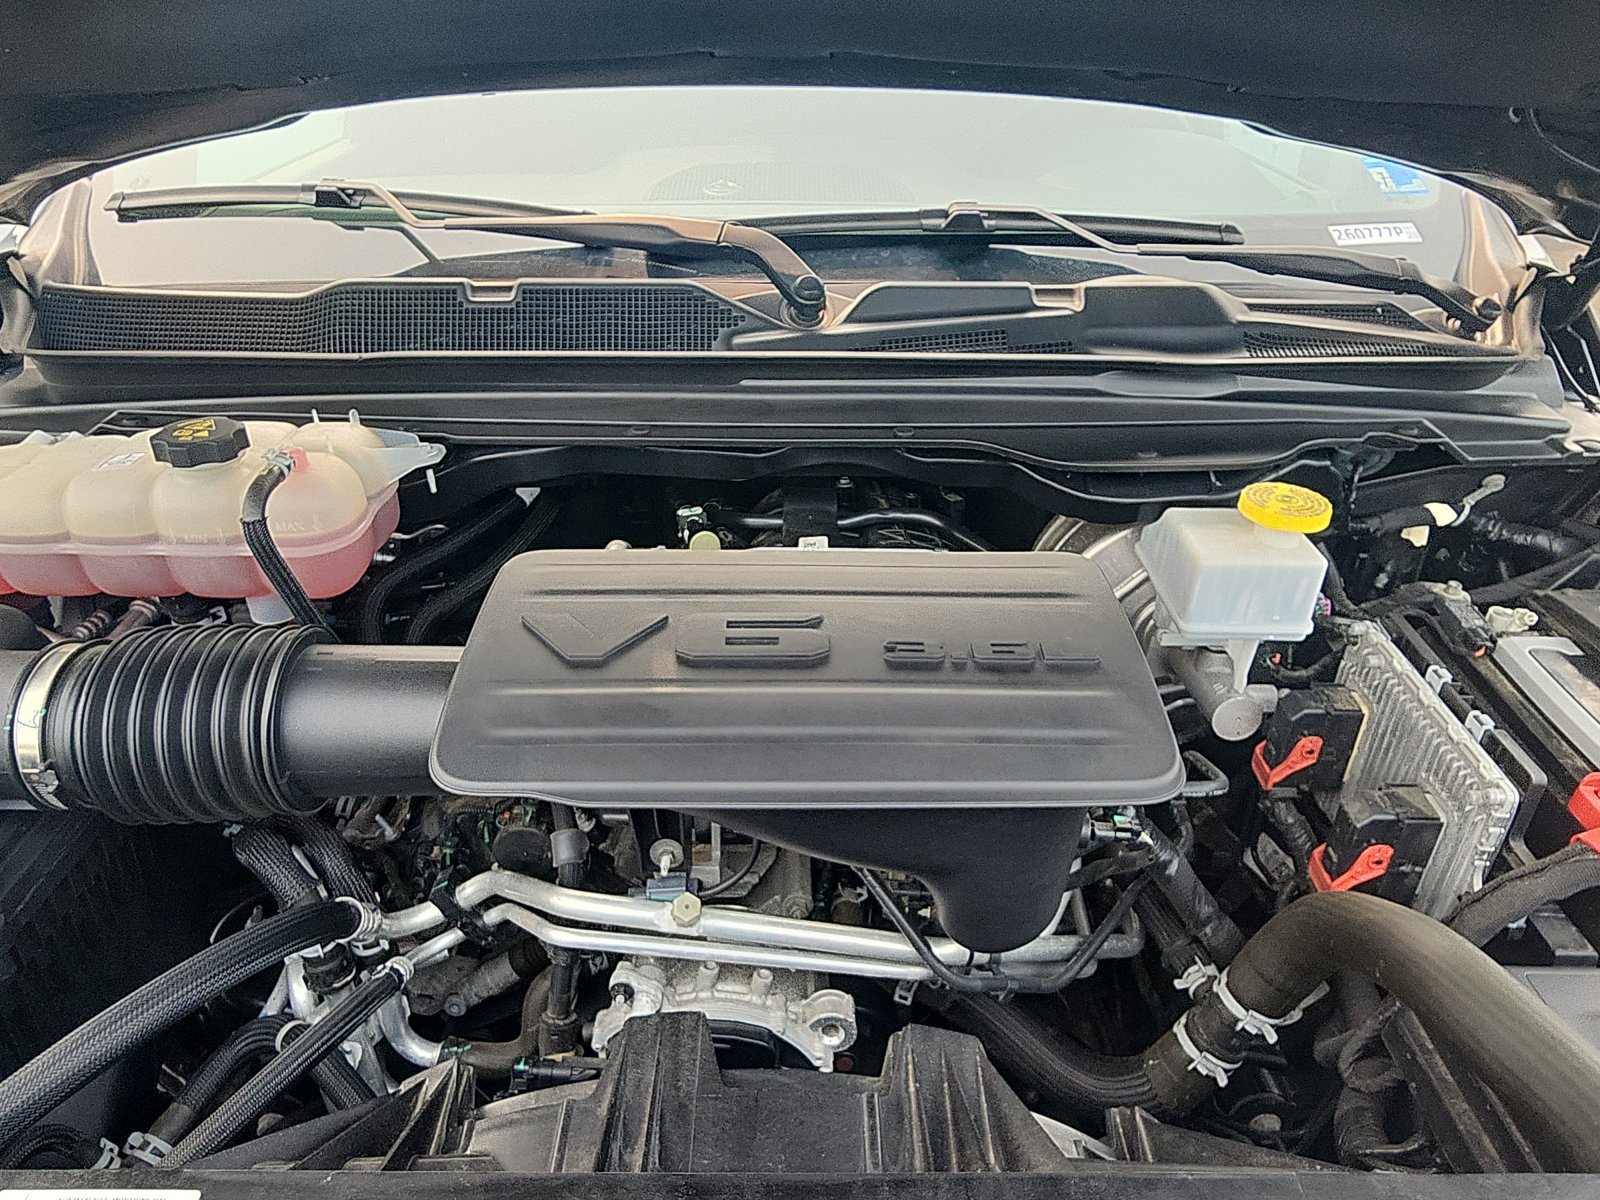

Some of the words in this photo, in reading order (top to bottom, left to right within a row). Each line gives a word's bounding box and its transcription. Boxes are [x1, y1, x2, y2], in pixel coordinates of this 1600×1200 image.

[1331, 226, 1404, 241] 260777P
[275, 522, 305, 532] MAX
[184, 534, 208, 543] MIN
